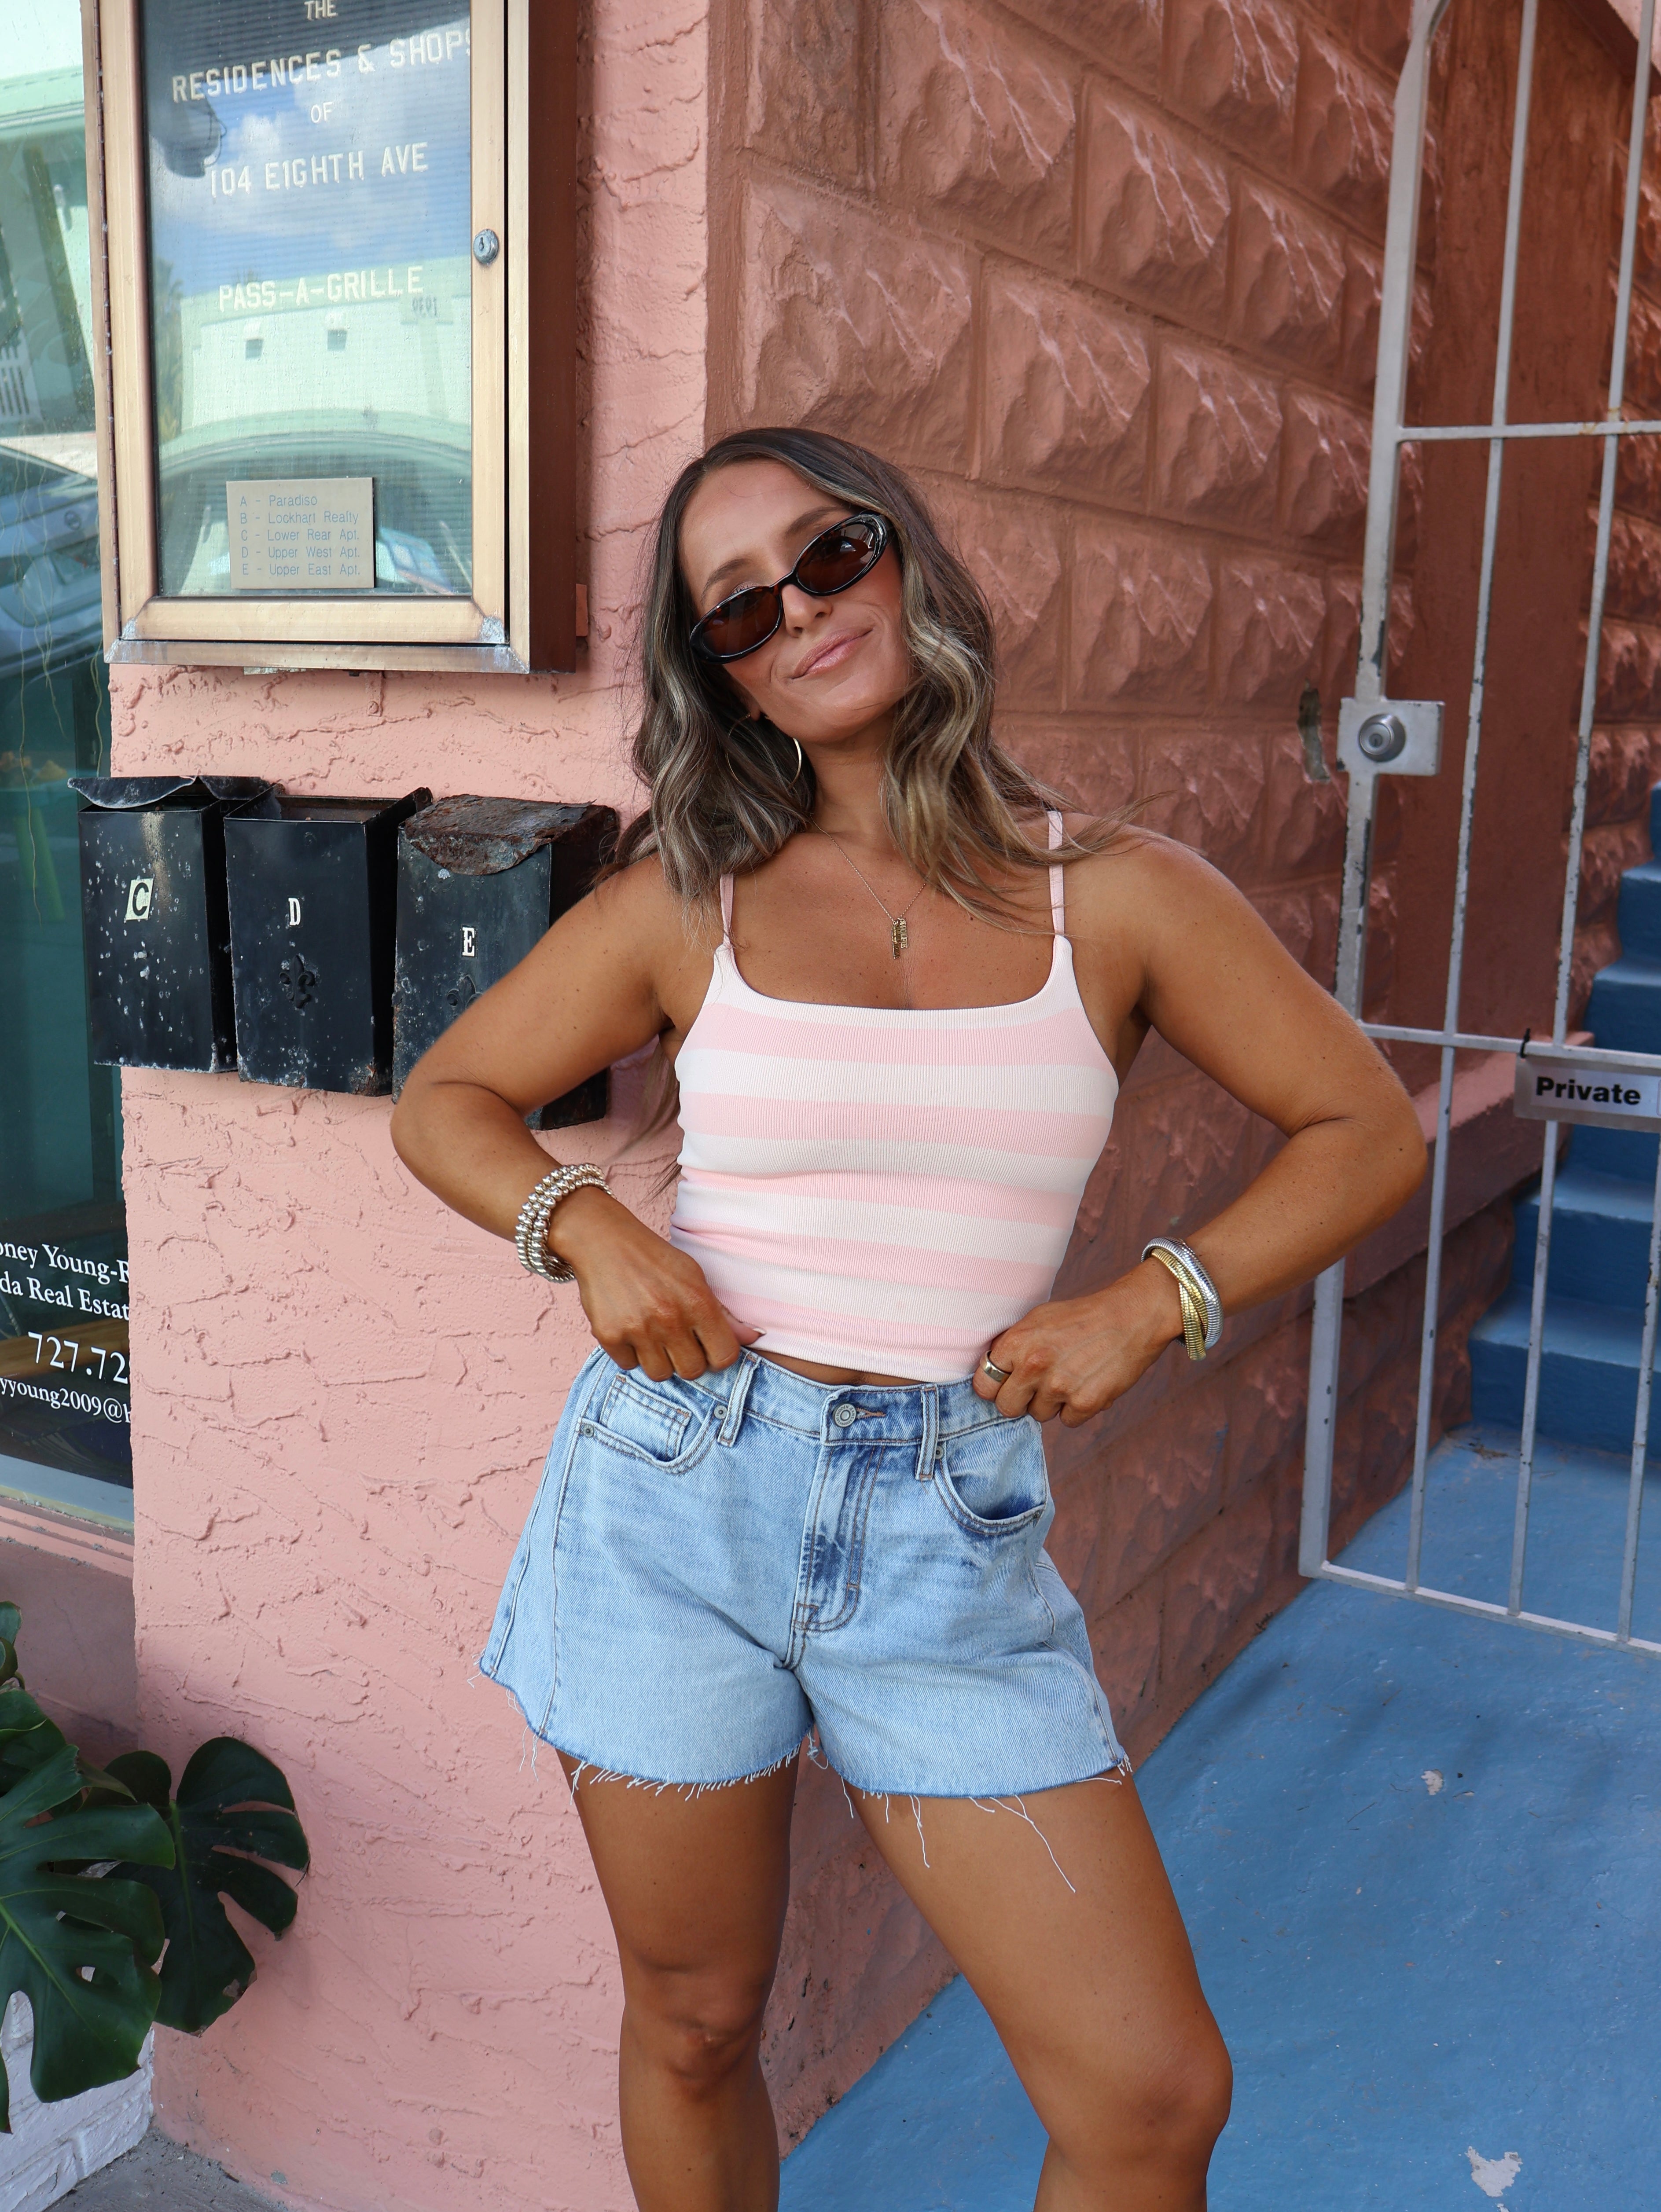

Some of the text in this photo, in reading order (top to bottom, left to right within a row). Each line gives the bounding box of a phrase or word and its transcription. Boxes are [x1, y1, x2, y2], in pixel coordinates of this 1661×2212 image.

[304, 0, 338, 21] THE
[172, 49, 342, 103] RESIDENCES
[357, 44, 376, 74] &
[311, 102, 333, 124] OF
[211, 166, 251, 198] 104
[381, 142, 429, 177] AVE
[219, 266, 424, 312] PASS-A-GRILLE
[240, 496, 247, 506] A
[269, 494, 317, 506] Paradiso
[240, 513, 247, 524] B
[268, 512, 316, 524] Lockhart
[324, 511, 359, 525] Realty
[241, 529, 247, 541] C
[268, 529, 299, 541] Lower
[308, 528, 331, 540] Rear
[339, 528, 359, 542] Apt.
[242, 547, 248, 558] D
[268, 547, 298, 560] Upper
[306, 546, 331, 558] West
[340, 546, 360, 559] Apt.
[243, 563, 249, 575] E
[269, 564, 300, 576] Upper
[308, 563, 331, 575] East
[339, 563, 360, 576] Apt.
[132, 882, 149, 916] C
[288, 898, 301, 925] D
[462, 927, 475, 957] E
[1536, 1076, 1641, 1105] Private
[26, 1277, 73, 1308] Real
